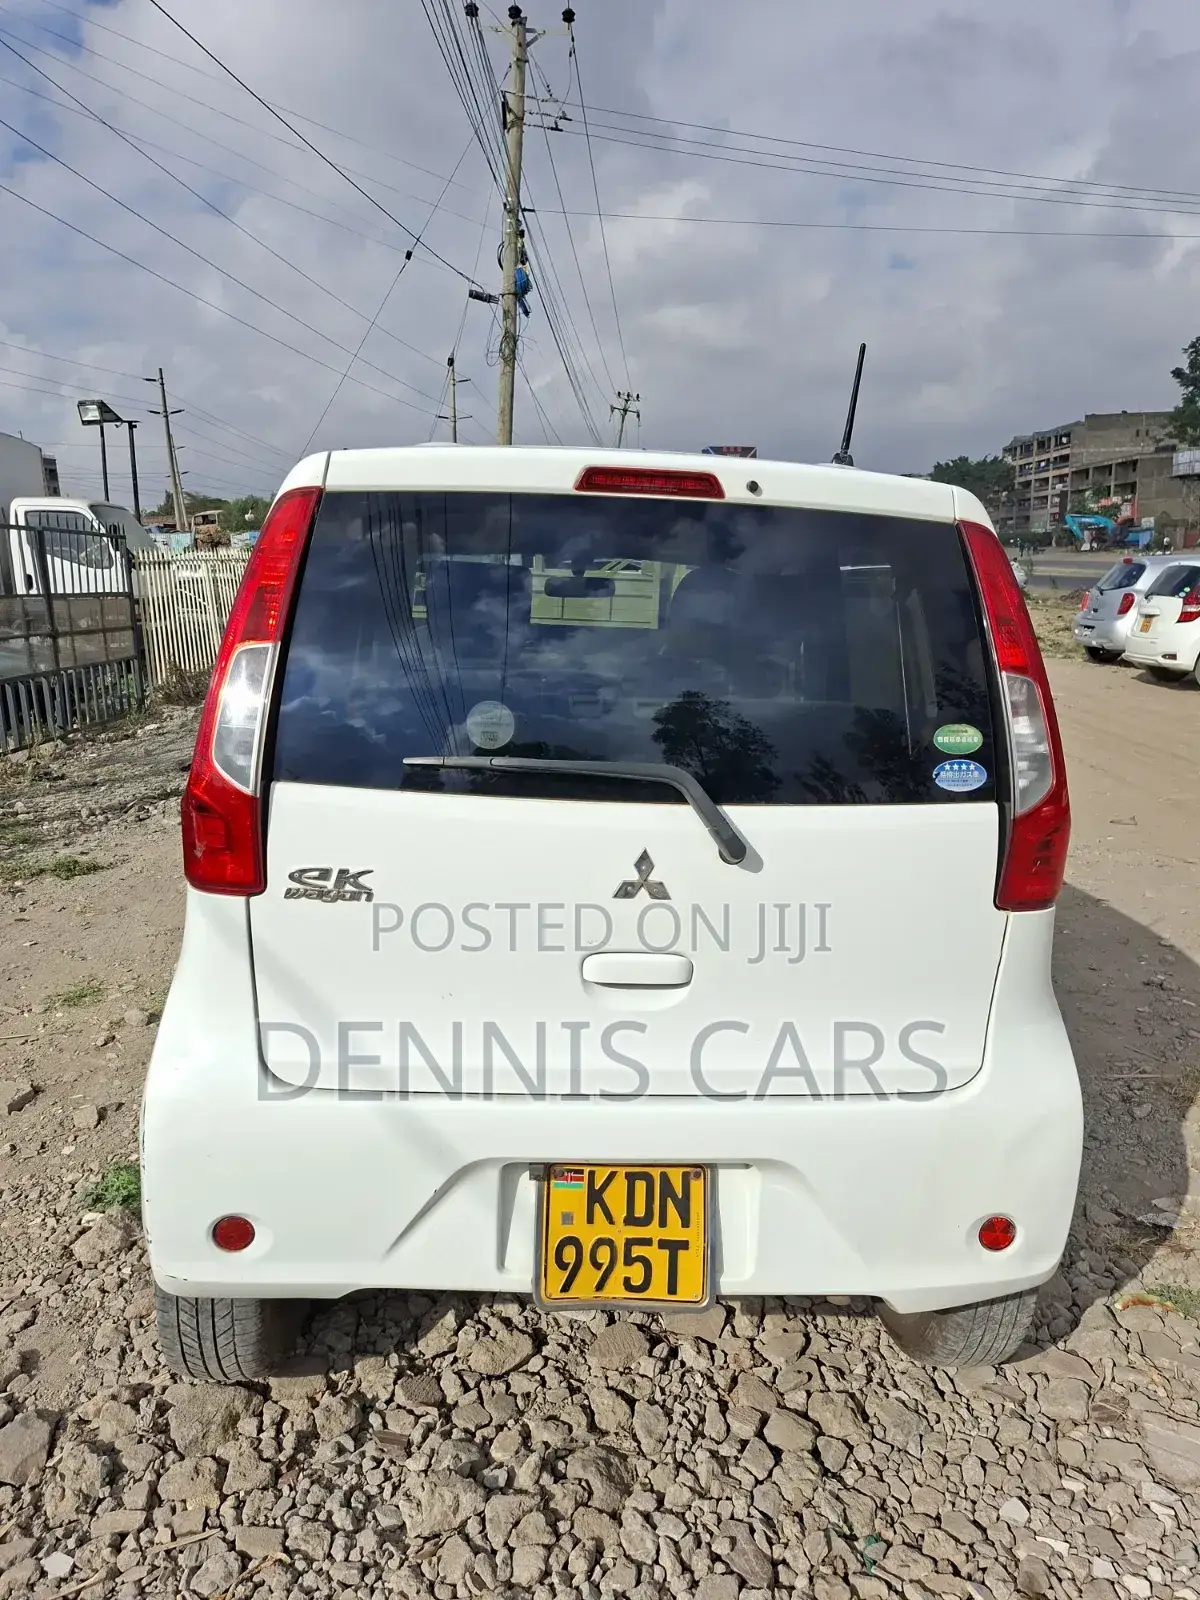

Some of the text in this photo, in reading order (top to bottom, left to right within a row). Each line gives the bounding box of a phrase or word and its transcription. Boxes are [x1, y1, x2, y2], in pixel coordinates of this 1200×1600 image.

[283, 887, 375, 904] wagon
[586, 1169, 691, 1228] KDN
[554, 1235, 690, 1296] 995T
